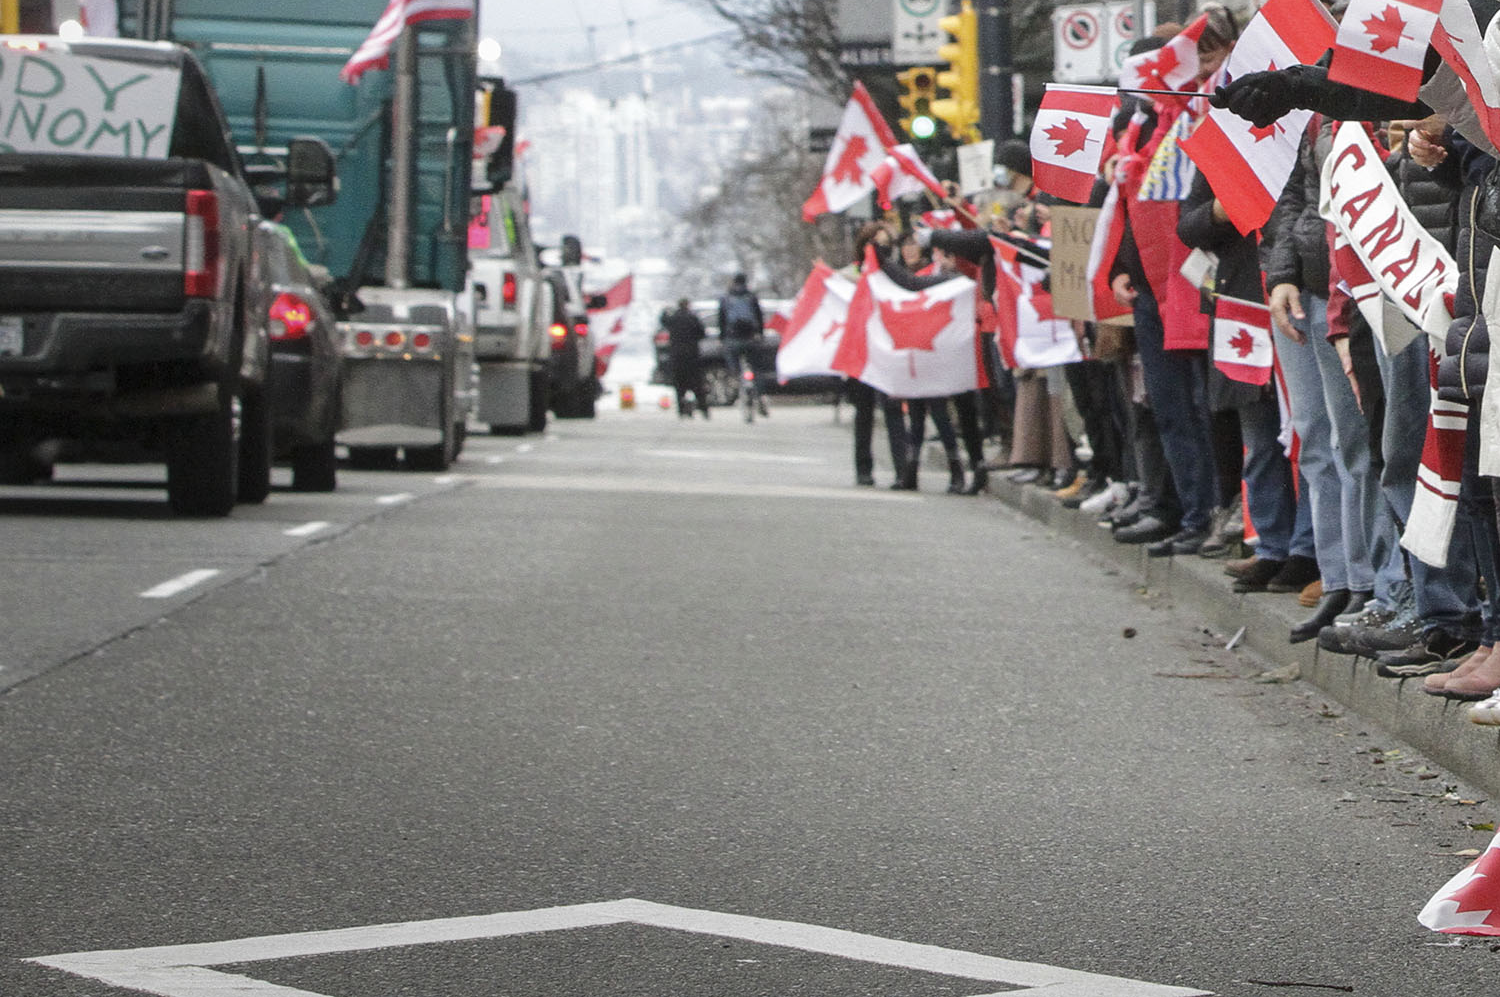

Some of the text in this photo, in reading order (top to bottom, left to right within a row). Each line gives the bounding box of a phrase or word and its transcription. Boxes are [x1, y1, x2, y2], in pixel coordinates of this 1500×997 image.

[0, 55, 152, 112] DY
[0, 98, 167, 157] NOMY
[1330, 143, 1447, 320] CANAD
